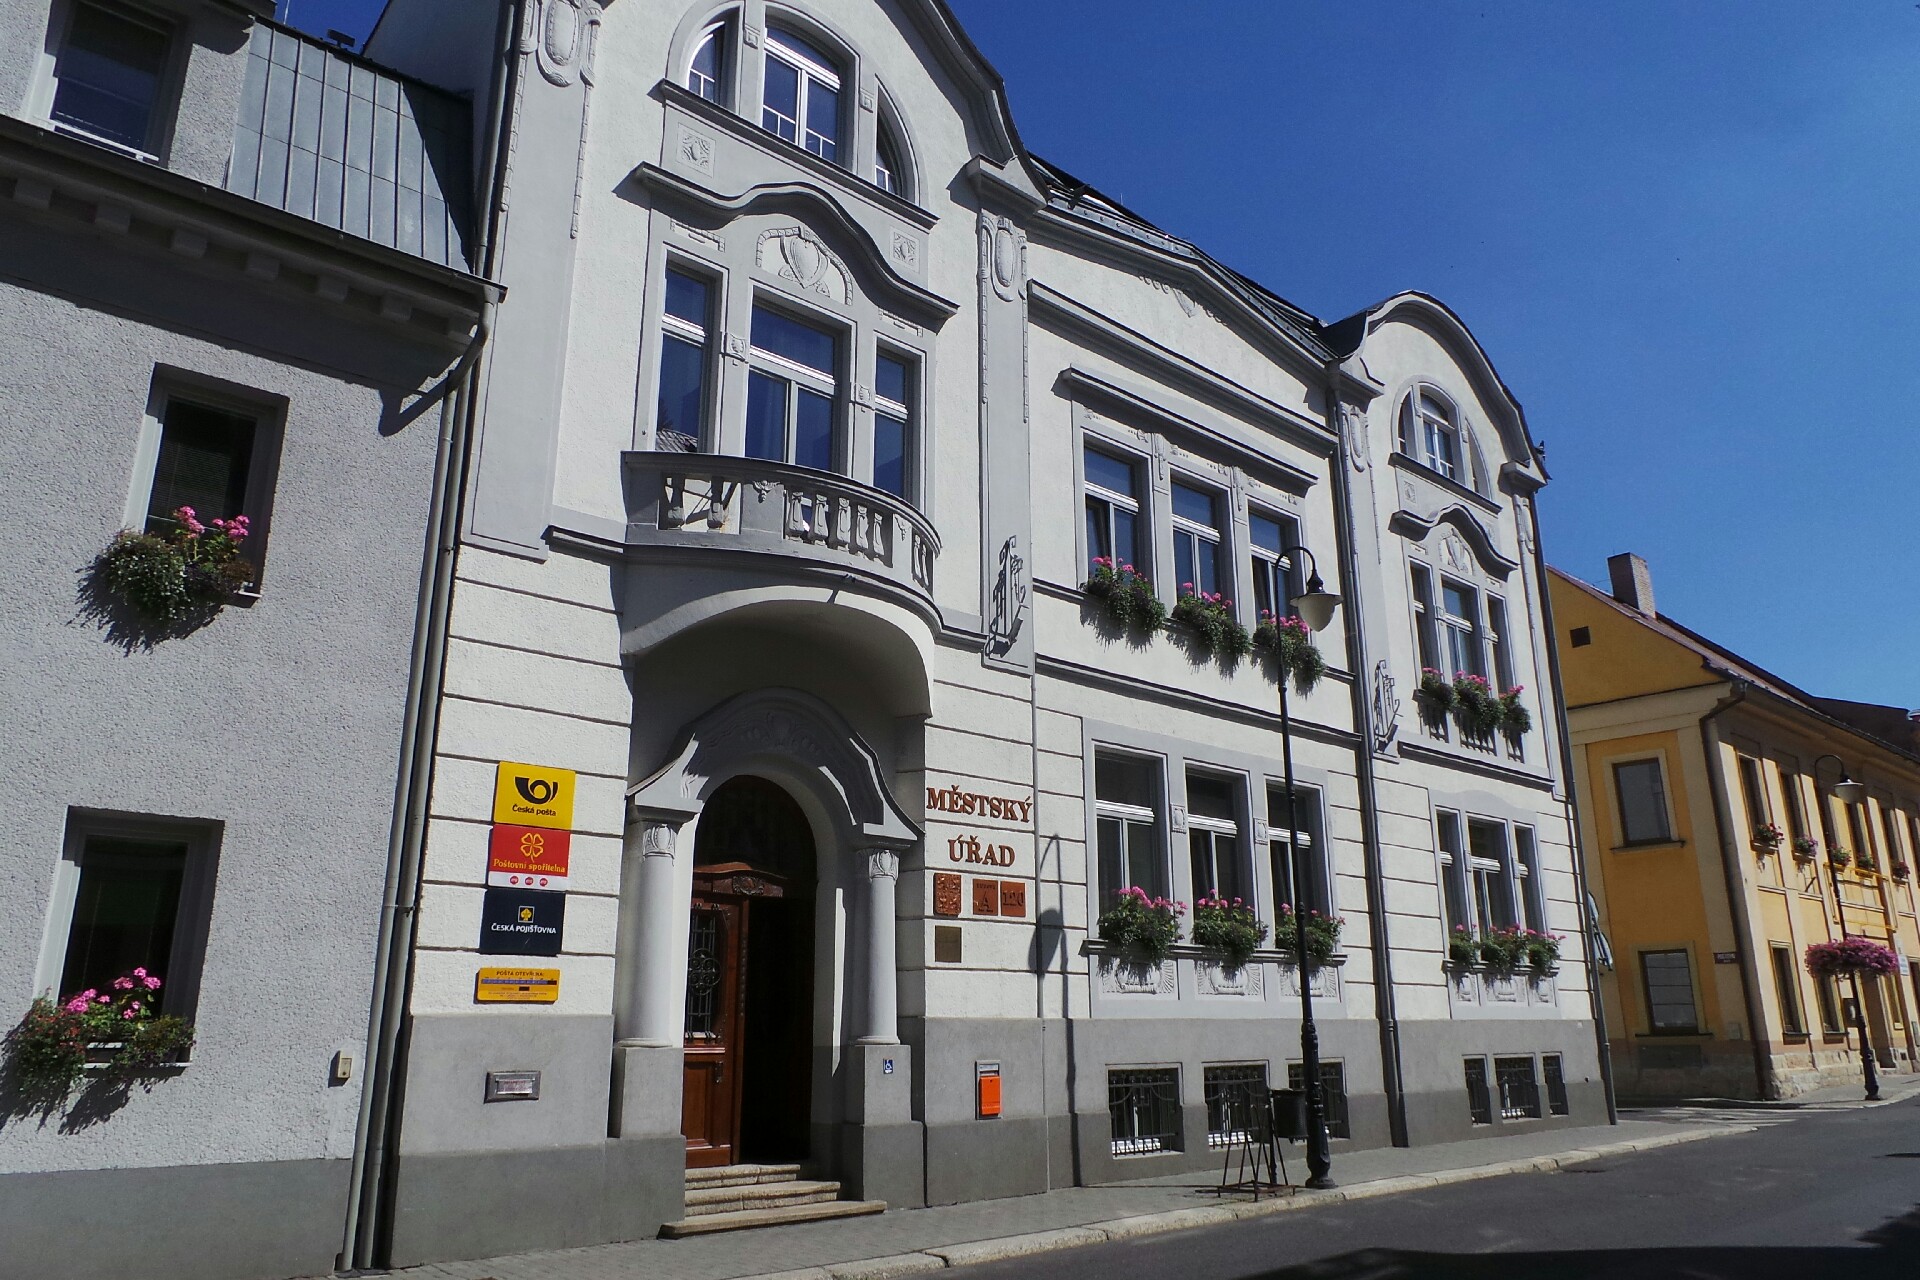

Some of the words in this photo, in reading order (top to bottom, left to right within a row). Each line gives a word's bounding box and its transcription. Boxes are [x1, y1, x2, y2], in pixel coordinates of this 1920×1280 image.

[512, 804, 534, 814] Česká
[536, 808, 556, 816] pošta
[926, 785, 1033, 823] MĚSTSKÝ
[947, 834, 1015, 867] ÚŘAD
[493, 858, 526, 870] Poštovní
[528, 863, 566, 873] spořitelna
[491, 922, 514, 932] ČESKÁ
[515, 924, 557, 934] POJIŠŤOVNA
